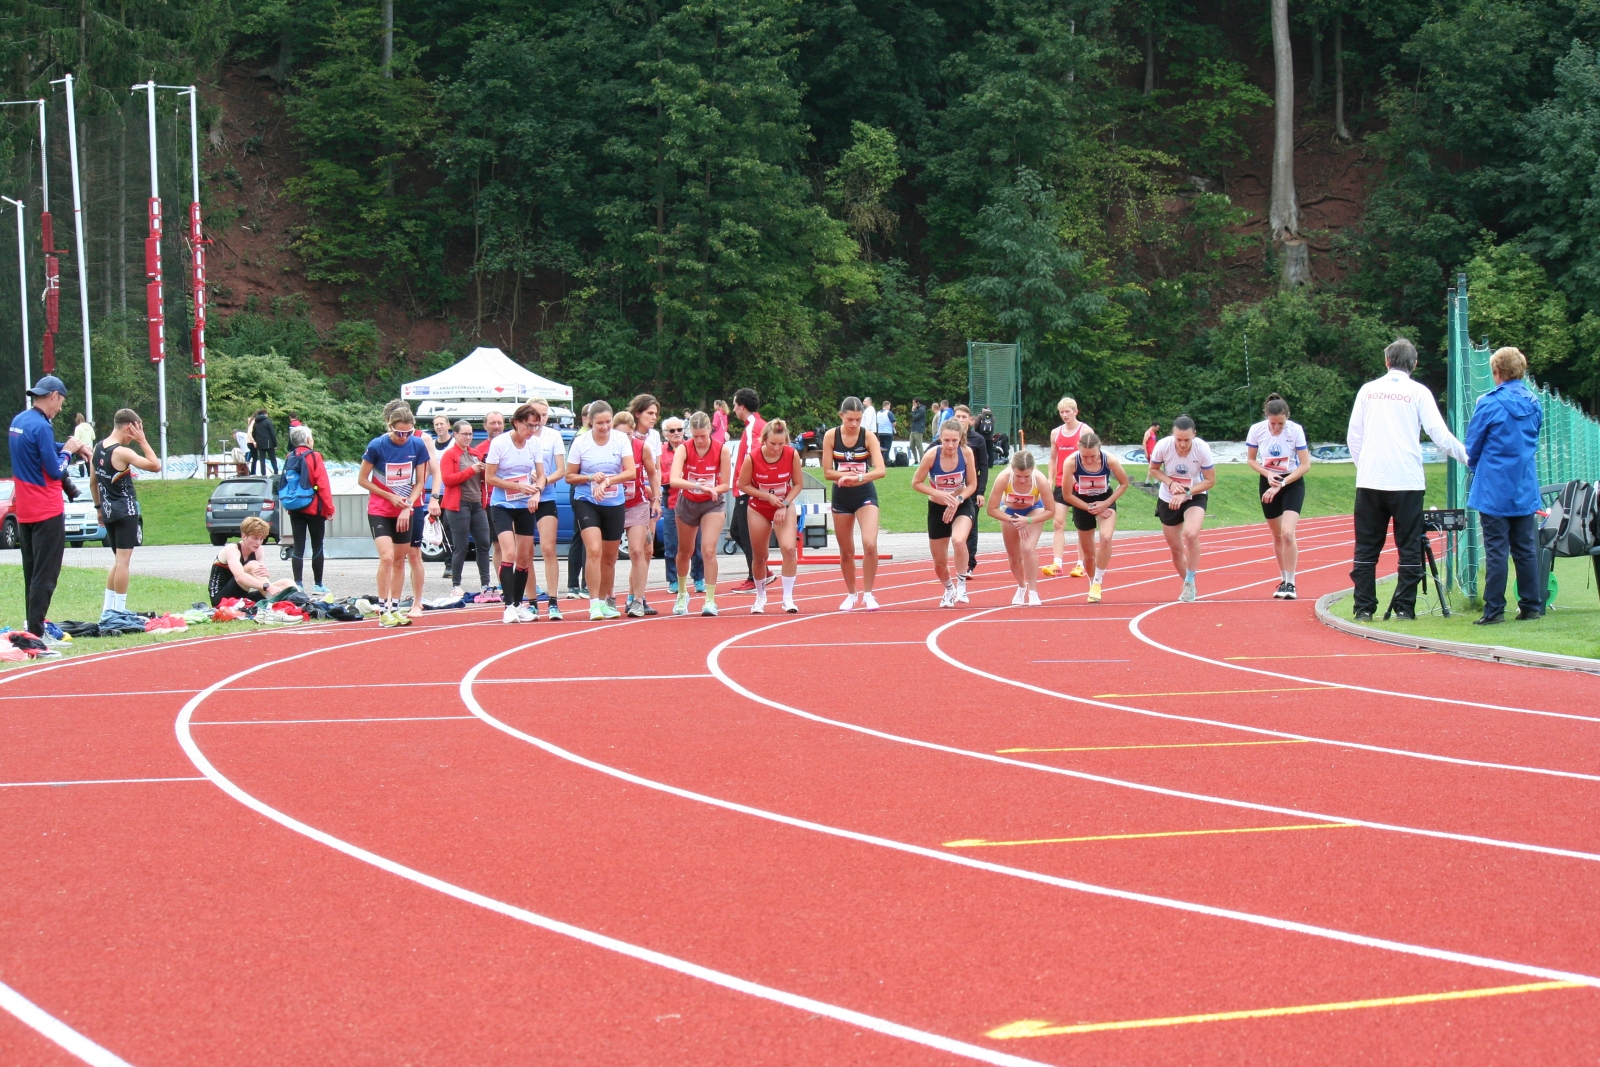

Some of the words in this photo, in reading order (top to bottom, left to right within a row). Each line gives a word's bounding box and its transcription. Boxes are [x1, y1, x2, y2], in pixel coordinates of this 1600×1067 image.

[1368, 392, 1412, 403] ROZHODČÍ
[396, 468, 402, 478] 4
[943, 477, 956, 486] 23
[769, 487, 775, 495] 6
[1013, 497, 1026, 505] 21
